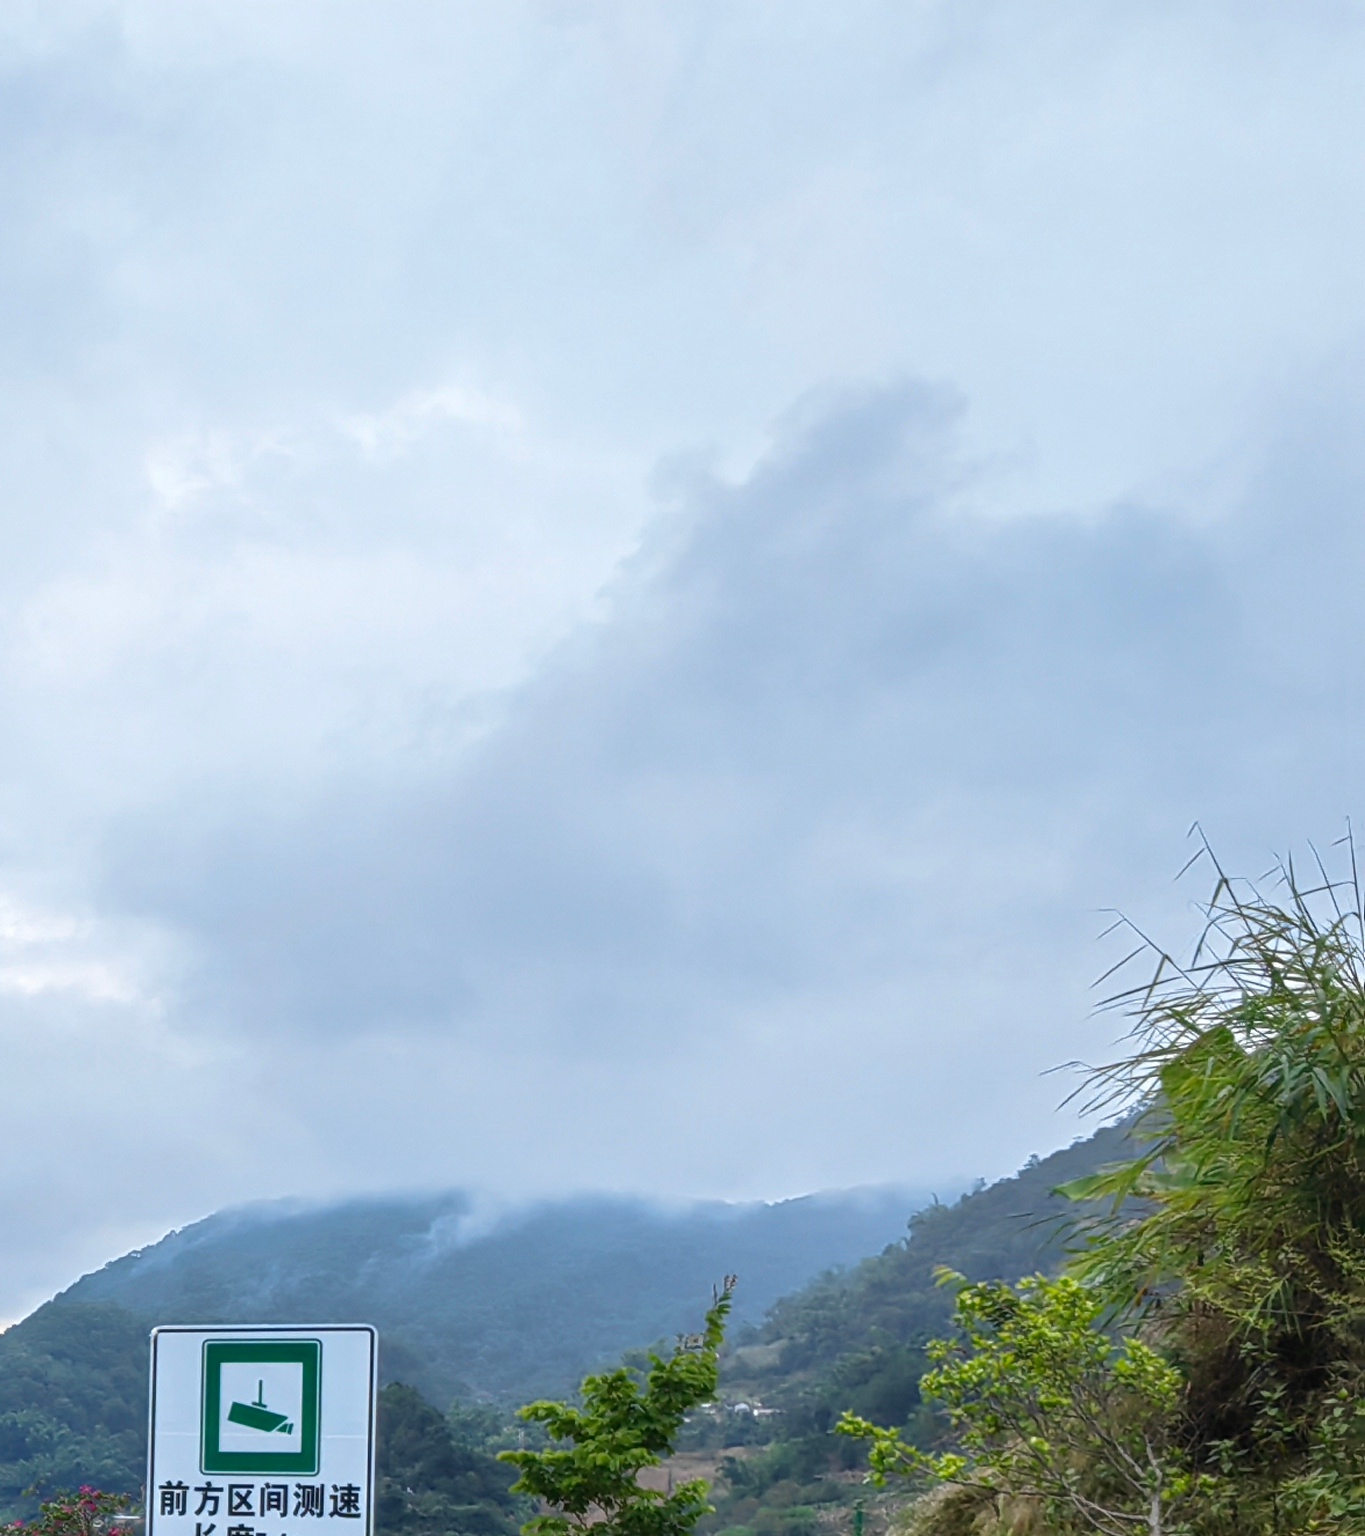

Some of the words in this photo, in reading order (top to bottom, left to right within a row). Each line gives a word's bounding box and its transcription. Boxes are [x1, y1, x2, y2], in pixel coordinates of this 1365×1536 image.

[158, 1480, 362, 1519] 前方区间测速
